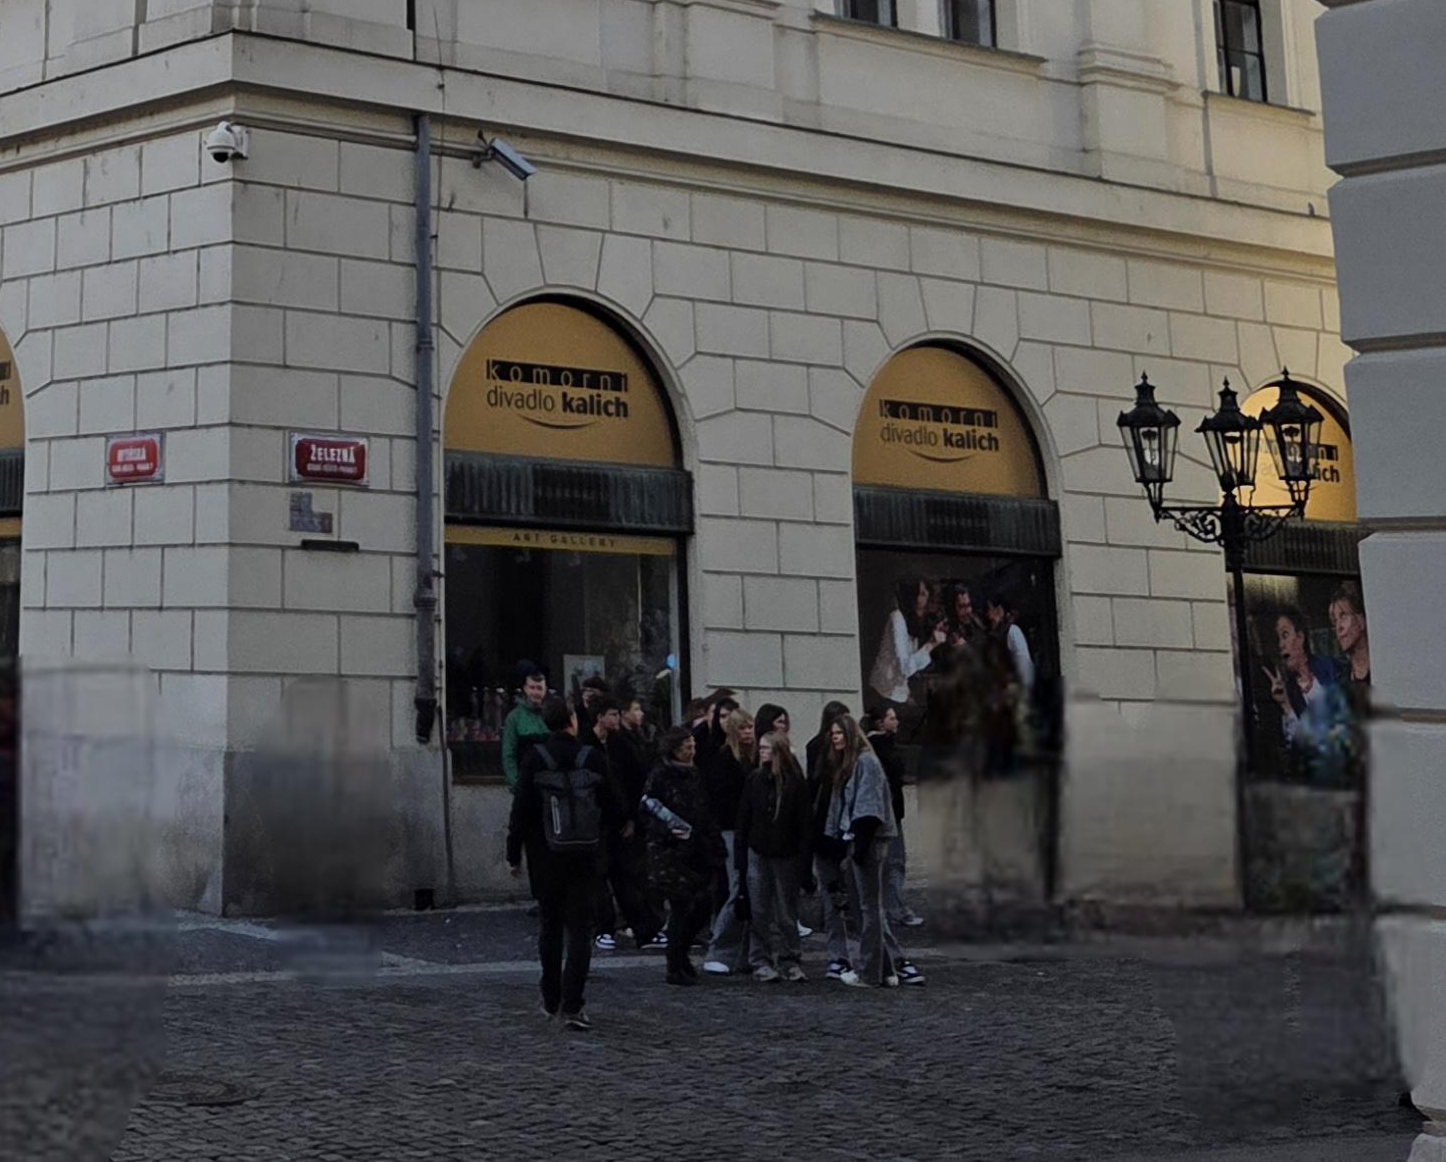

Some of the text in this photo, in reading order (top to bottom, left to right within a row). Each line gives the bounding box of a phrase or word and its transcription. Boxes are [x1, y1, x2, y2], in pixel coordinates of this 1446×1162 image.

[487, 385, 629, 418] divadlo kalich
[880, 423, 999, 451] divadlo kalich
[310, 444, 356, 463] ŽELEZNÁ
[513, 533, 615, 549] ART GALLERY
